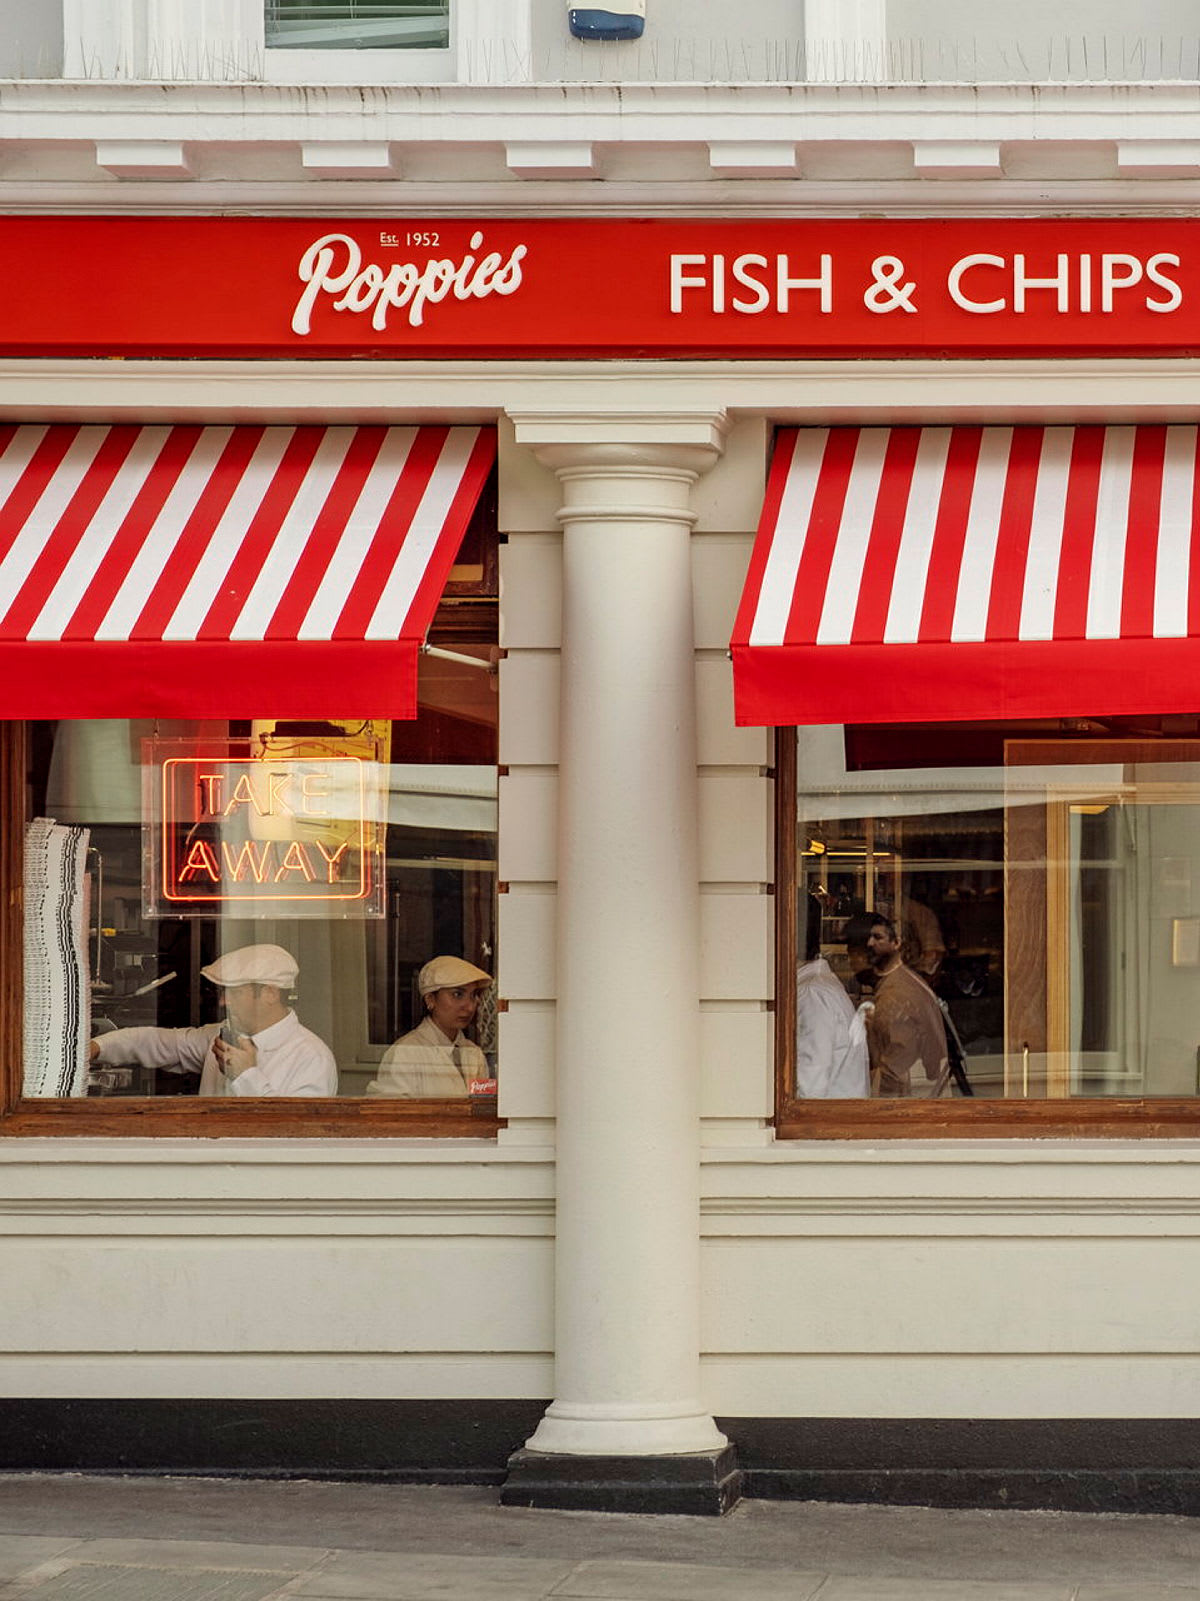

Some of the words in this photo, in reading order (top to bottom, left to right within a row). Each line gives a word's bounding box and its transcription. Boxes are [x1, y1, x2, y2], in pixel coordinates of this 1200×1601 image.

[380, 232, 399, 246] Est.
[406, 232, 440, 247] 1952
[291, 231, 528, 335] Poppies
[670, 253, 832, 314] FISH
[863, 255, 918, 314] &
[947, 252, 1183, 314] CHIPS
[199, 772, 328, 817] TAKE
[178, 839, 348, 884] AWAY
